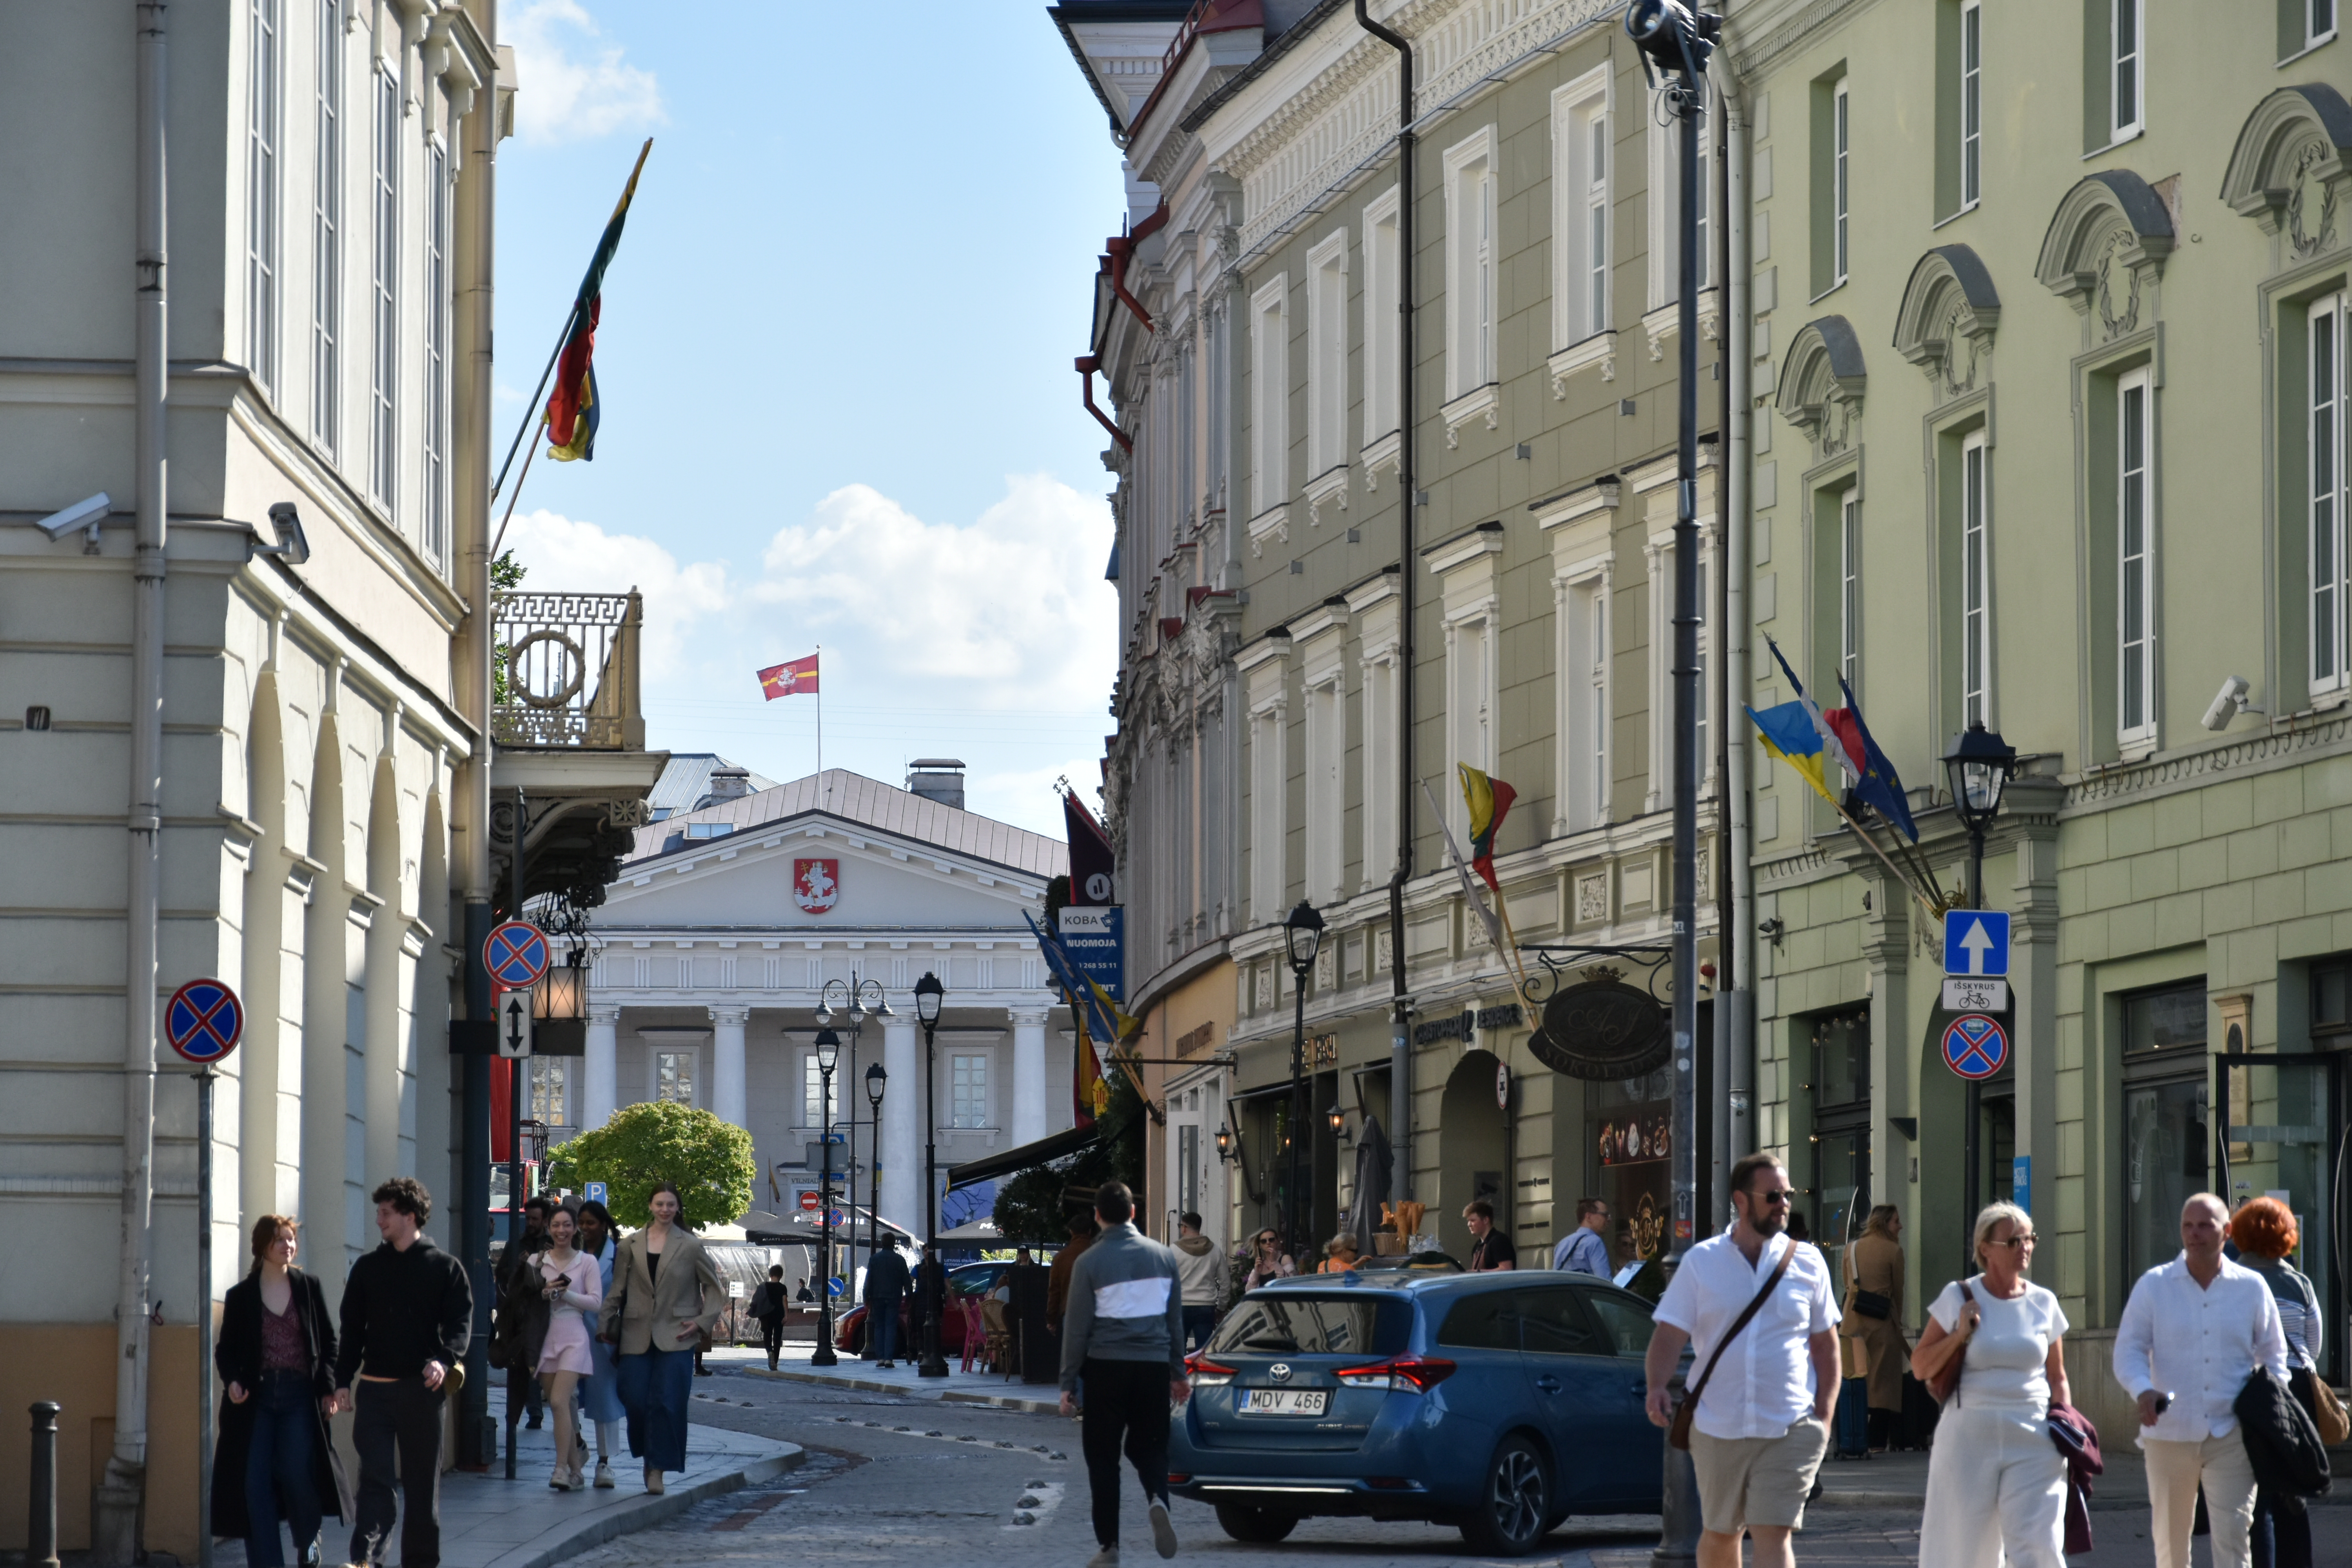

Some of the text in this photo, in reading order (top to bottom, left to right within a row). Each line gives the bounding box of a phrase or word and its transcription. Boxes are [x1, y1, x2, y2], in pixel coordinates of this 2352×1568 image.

[1065, 916, 1098, 924] KOBA
[1955, 981, 1995, 990] IŠSKYRUS
[591, 1185, 602, 1201] P
[1250, 1392, 1323, 1409] MDV 466
